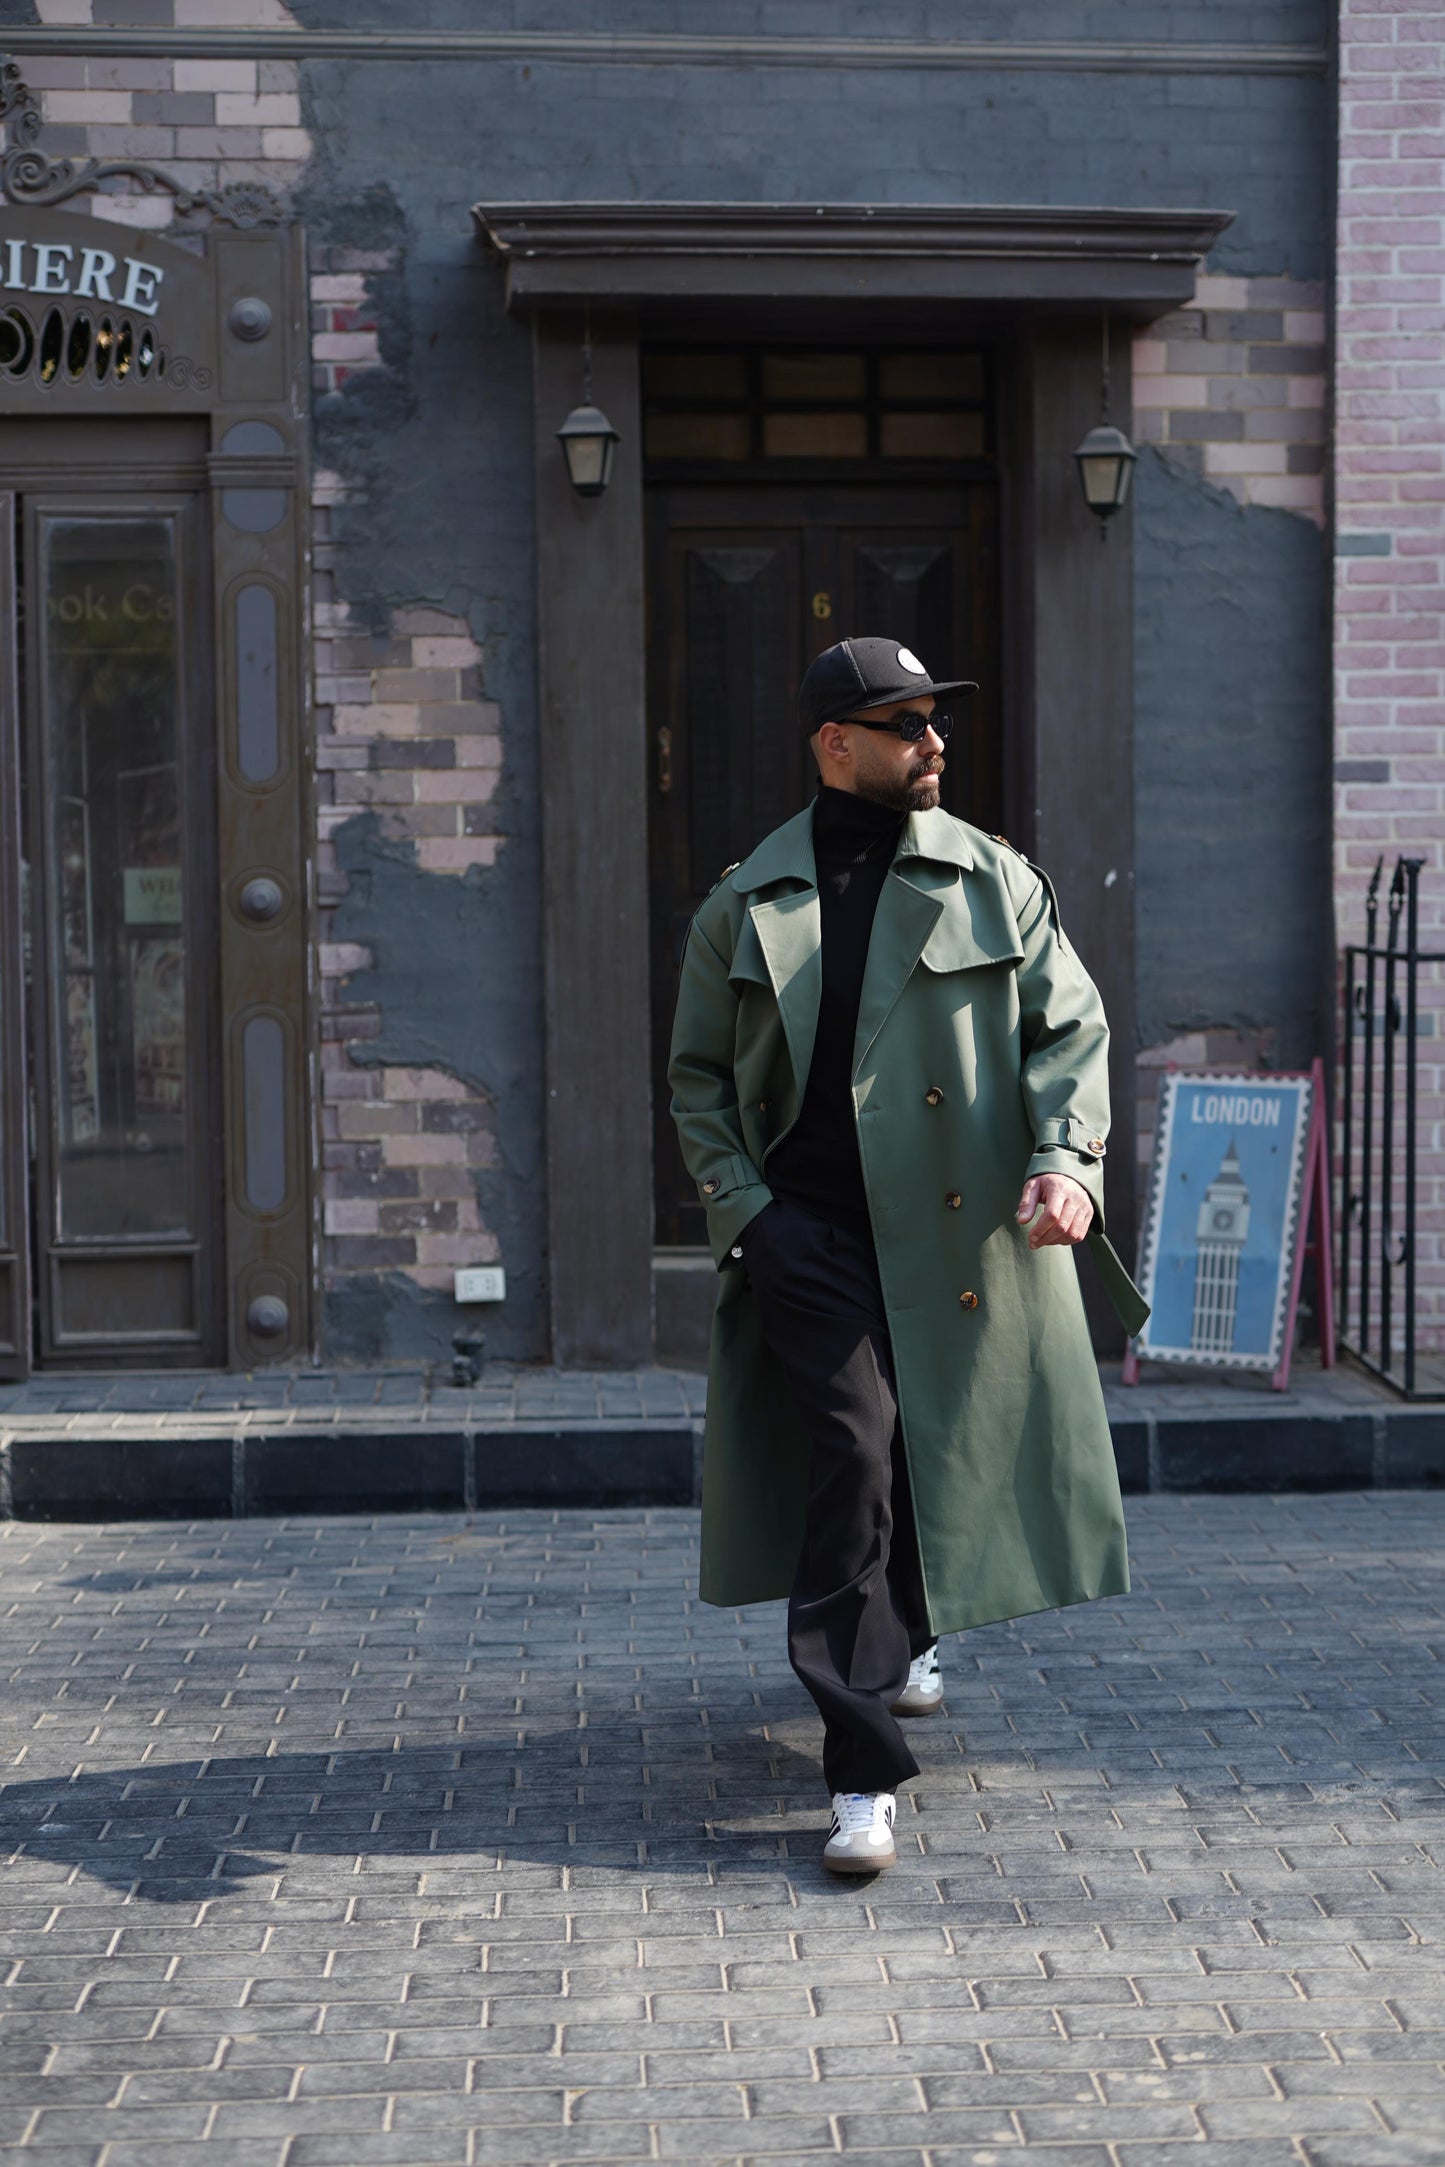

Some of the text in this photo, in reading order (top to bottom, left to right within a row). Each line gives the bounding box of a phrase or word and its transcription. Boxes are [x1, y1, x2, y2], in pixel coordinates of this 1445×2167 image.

[0, 239, 164, 316] IERE
[812, 592, 832, 619] 6
[1191, 1094, 1281, 1127] LONDON
